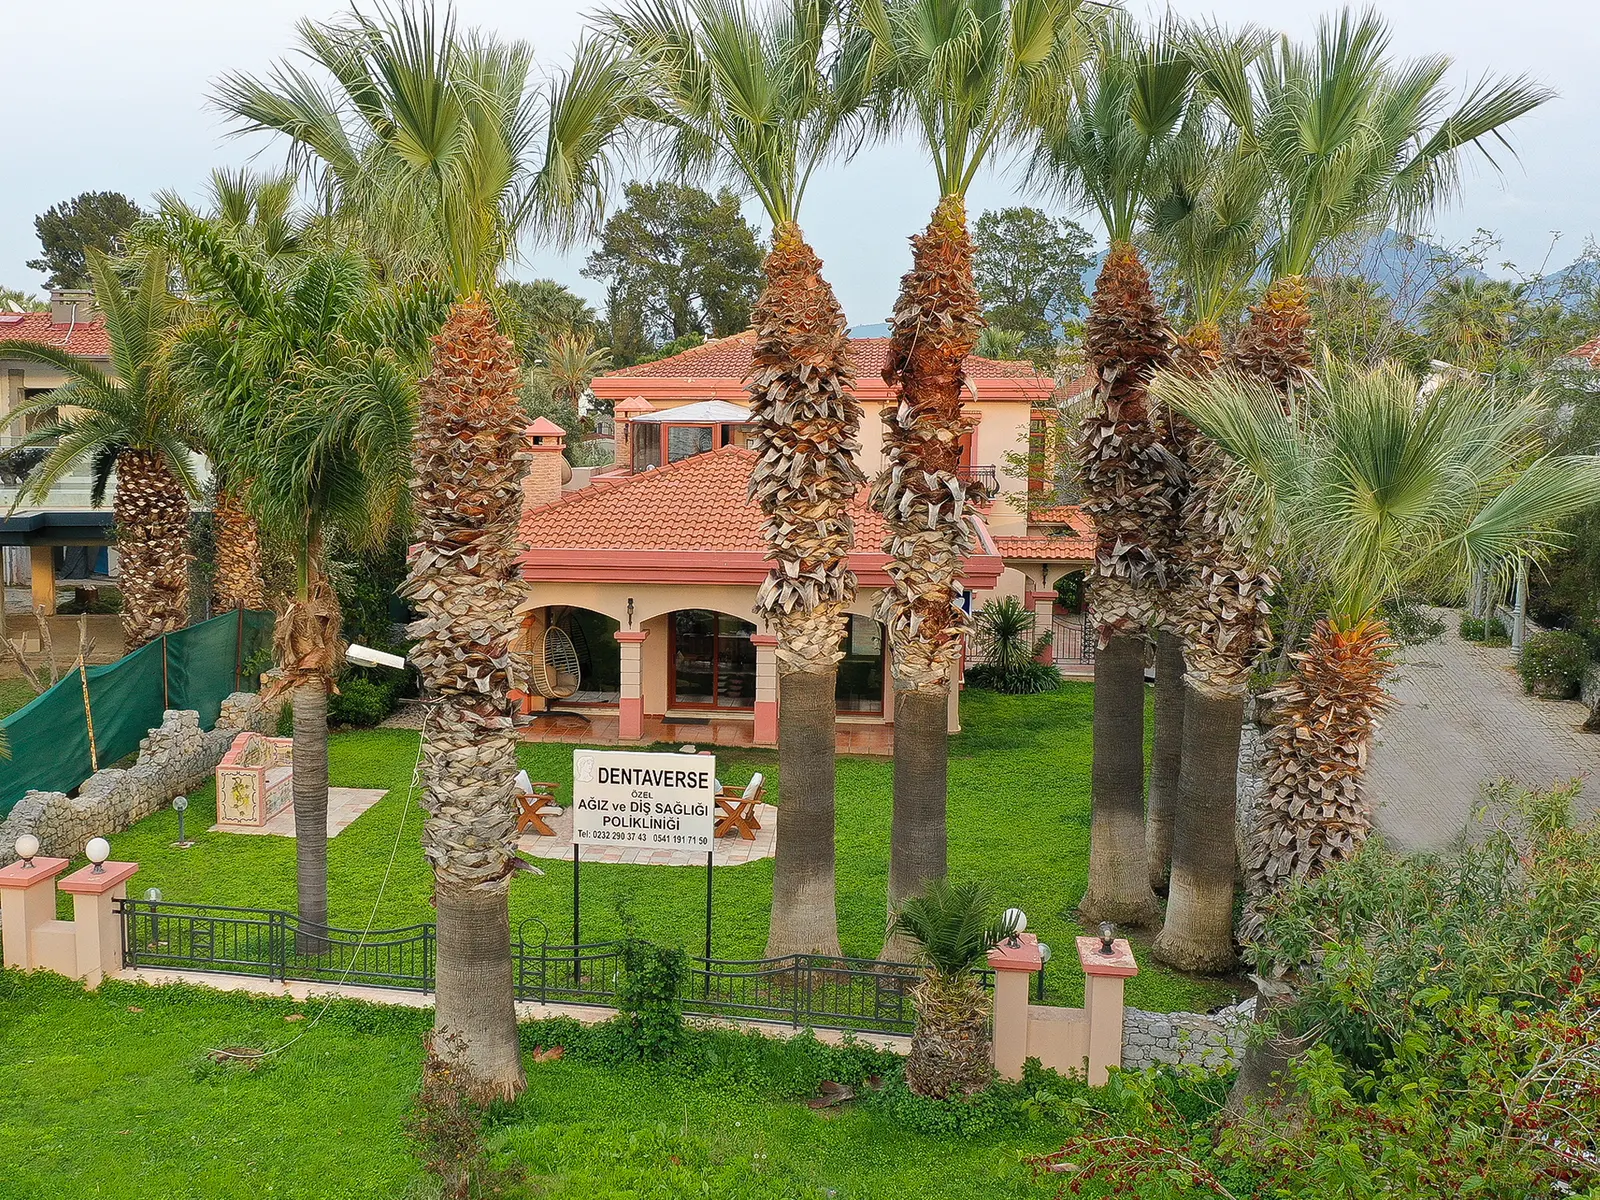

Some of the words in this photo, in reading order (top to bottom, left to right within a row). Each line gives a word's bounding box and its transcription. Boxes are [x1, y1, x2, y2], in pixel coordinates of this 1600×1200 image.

[598, 767, 708, 788] DENTAVERSE
[631, 790, 653, 799] ÖZEL
[578, 797, 608, 810] AĞIZ
[612, 803, 626, 811] ve
[630, 800, 651, 816] DİŞ
[655, 802, 708, 816] SAĞLIĞI
[603, 815, 679, 830] POLİKLİNİĞİ
[578, 830, 590, 838] Tel:
[593, 830, 610, 839] 0232
[611, 832, 625, 840] 290
[638, 833, 646, 841] 43
[653, 834, 670, 842] 0541
[673, 835, 685, 844] 191
[688, 836, 696, 844] 71
